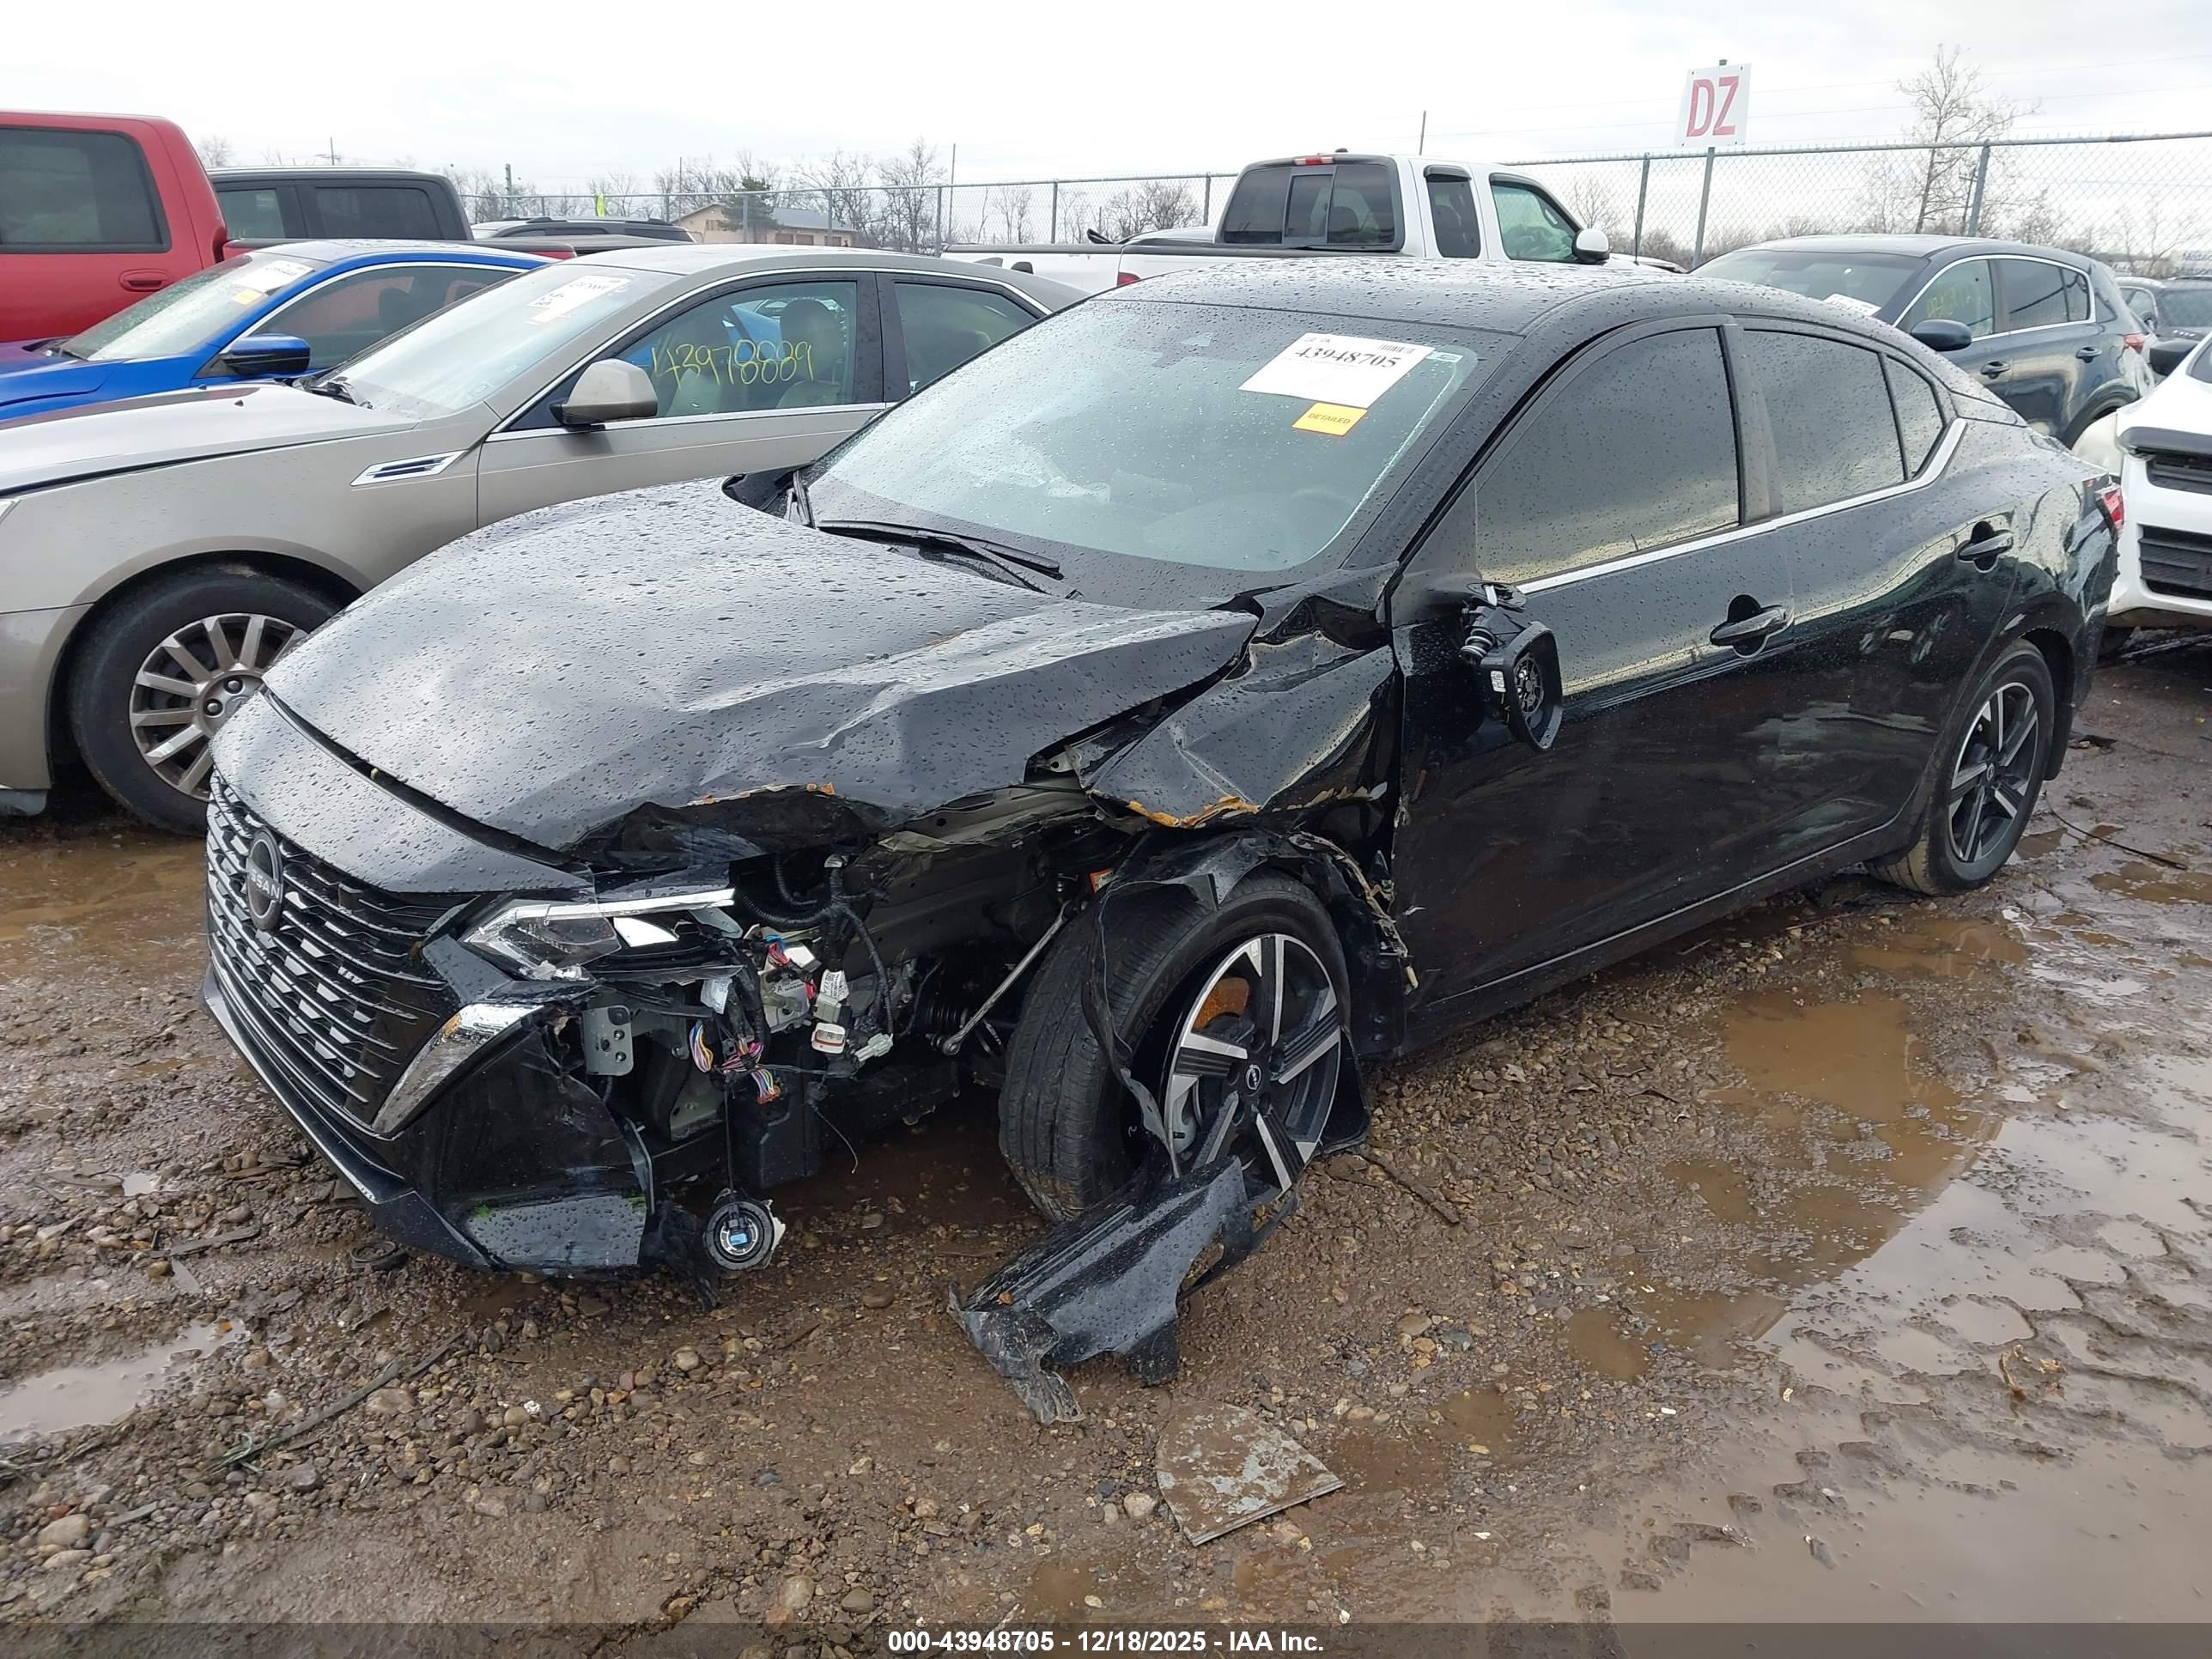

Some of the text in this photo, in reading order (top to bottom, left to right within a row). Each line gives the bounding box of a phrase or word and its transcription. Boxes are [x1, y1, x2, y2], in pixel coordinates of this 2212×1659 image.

[1686, 75, 1740, 137] DZ
[651, 338, 814, 392] 43978889
[1295, 347, 1401, 368] 43948705
[1307, 412, 1351, 424] DETAILED
[250, 868, 280, 899] SSAN
